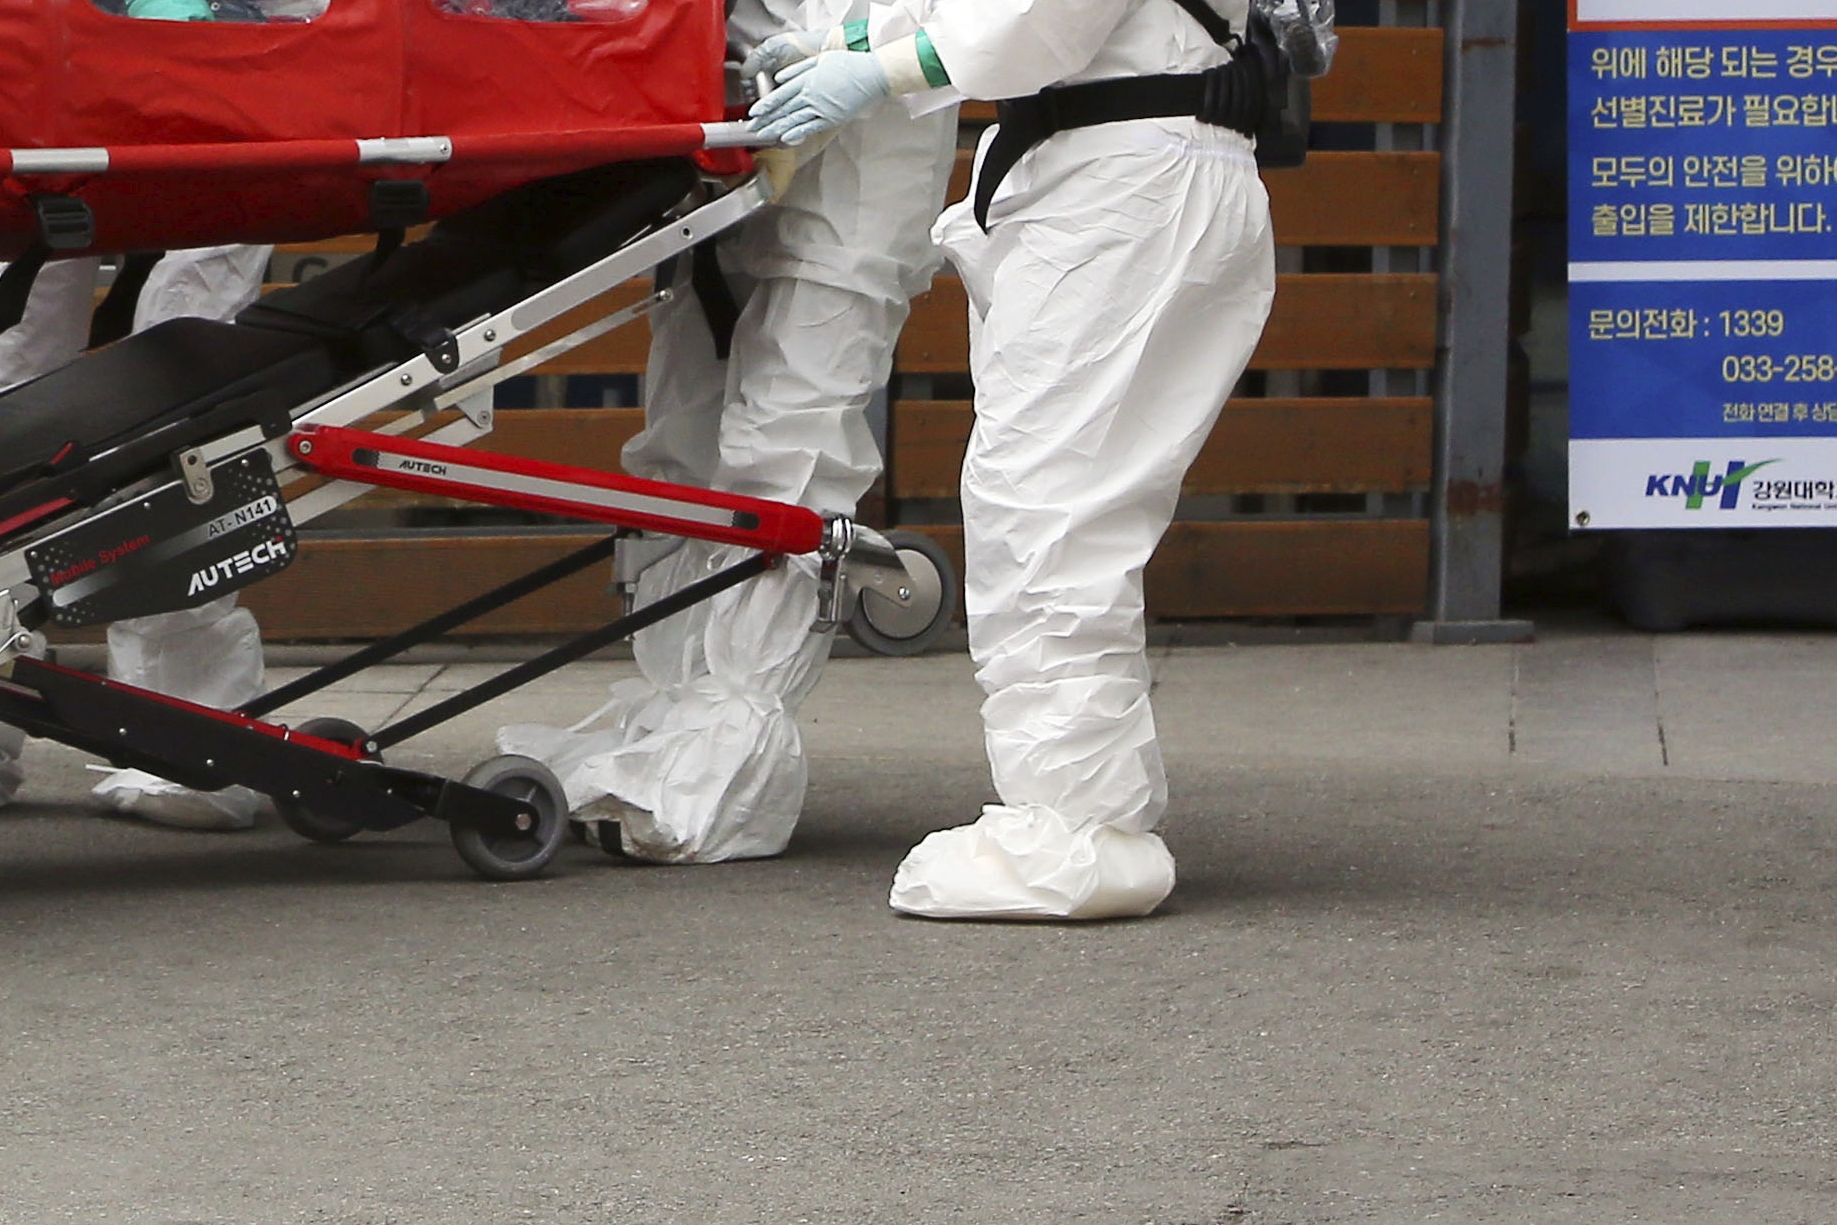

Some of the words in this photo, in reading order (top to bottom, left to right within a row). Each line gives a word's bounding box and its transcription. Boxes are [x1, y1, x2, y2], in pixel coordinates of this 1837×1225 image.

[1591, 47, 1648, 79] 위에
[1656, 46, 1714, 79] 해당
[1720, 46, 1778, 78] 되는
[1591, 95, 1737, 128] 선별진료가
[1743, 94, 1837, 127] 필요합
[1591, 156, 1674, 188] 모두의
[1683, 155, 1768, 188] 안전을
[1775, 154, 1837, 187] 위하
[1591, 204, 1675, 236] 출입을
[1684, 203, 1832, 235] 제한합니다.
[1718, 310, 1784, 337] 1339
[1722, 355, 1837, 383] 033-258
[1723, 402, 1755, 423] 전화
[1757, 402, 1789, 423] 연결
[398, 460, 447, 476] AUTECH
[1753, 480, 1837, 501] 강원대학
[187, 537, 288, 597] AUTECH
